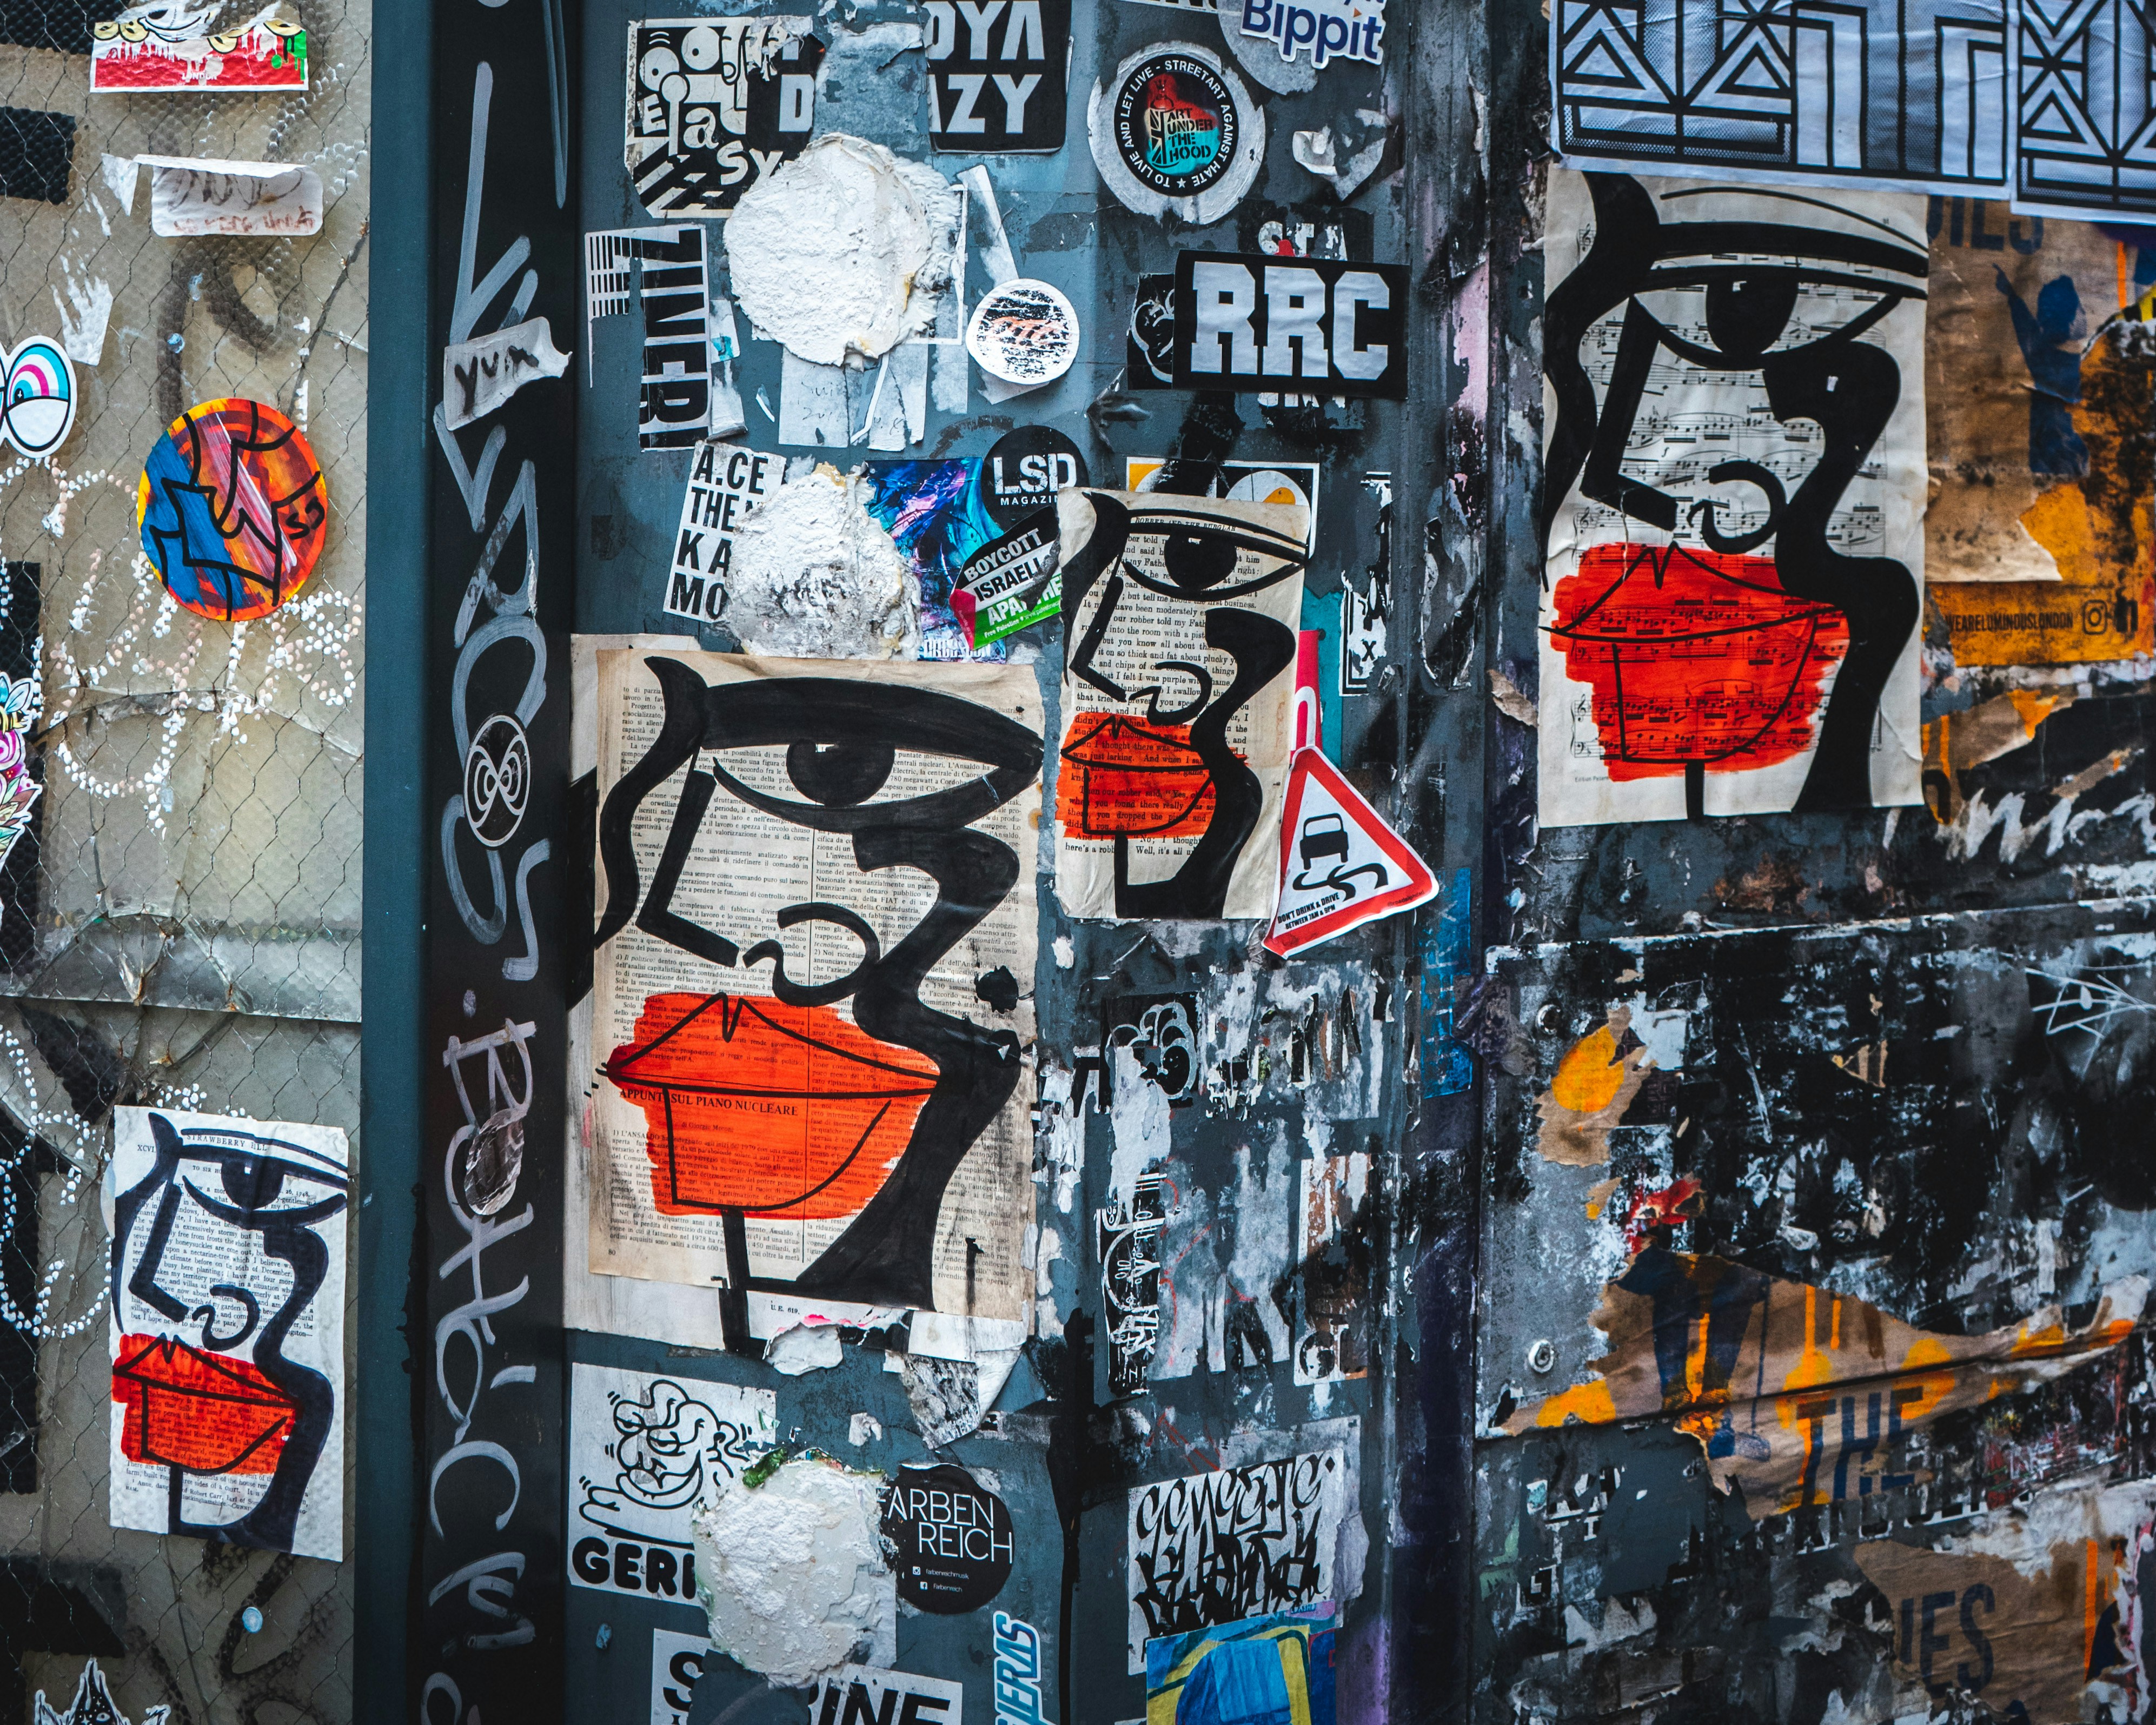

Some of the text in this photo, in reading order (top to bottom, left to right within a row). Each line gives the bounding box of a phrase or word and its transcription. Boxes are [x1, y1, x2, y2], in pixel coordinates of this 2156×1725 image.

[1242, 0, 1382, 63] Bippit
[1130, 66, 1154, 92] LIVE
[1120, 91, 1134, 118] LET
[1167, 119, 1212, 135] UNDER
[1220, 104, 1233, 162] AGAINST
[1121, 122, 1135, 148] AND
[1168, 133, 1196, 148] THE
[1169, 145, 1211, 163] HOOD
[1130, 150, 1152, 178] LIVE
[1192, 160, 1221, 187] HATE
[1155, 174, 1170, 188] TO
[1191, 261, 1389, 380] RRC
[993, 453, 1077, 495] LSD
[691, 486, 739, 532] THE
[1144, 535, 1158, 544] told
[964, 528, 1041, 582] BOYCOTT
[1140, 546, 1155, 554] said
[670, 572, 728, 619] MO
[1143, 593, 1155, 601] tell
[1224, 599, 1256, 608] business.
[1157, 607, 1197, 617] moderately
[984, 629, 996, 638] Free
[997, 619, 1019, 631] Palestine
[1175, 620, 1186, 628] my
[1103, 636, 1114, 645] but
[1137, 639, 1157, 647] know
[1128, 649, 1147, 658] thick
[1150, 651, 1164, 659] and
[1180, 653, 1201, 661] about
[1204, 655, 1228, 666] plucky
[1116, 661, 1135, 670] chips
[1212, 667, 1235, 675] things
[1124, 672, 1136, 680] felt
[1163, 675, 1186, 685] purple
[1077, 692, 1093, 701] that
[1076, 705, 1099, 714] ought
[1075, 716, 1099, 725] didn't
[1102, 740, 1132, 751] thought
[1144, 754, 1159, 762] And
[715, 829, 757, 838] valorizzazione
[855, 879, 904, 888] sostanzialmente
[816, 892, 859, 902] Finmeccanica,
[893, 890, 921, 898] pubblico
[1277, 910, 1295, 924] DON'T
[1296, 903, 1315, 916] DRINK
[1321, 892, 1340, 905] DRIVE
[1285, 916, 1308, 929] BETWEEN
[1309, 912, 1319, 920] 7AM
[1325, 904, 1336, 913] 9PM
[671, 1093, 693, 1105] SUL
[696, 1097, 732, 1109] PIANO
[735, 1100, 798, 1116] NUCLEARE
[187, 1134, 245, 1147] STRAWBERRY
[183, 1224, 237, 1238] excessively stormy
[176, 1239, 213, 1250] honeysuckles
[170, 1254, 191, 1263] climate
[164, 1262, 177, 1270] busy
[262, 1267, 292, 1277] December.
[183, 1272, 208, 1283] territory
[182, 1297, 204, 1305] breadth
[919, 1521, 1012, 1564] REICH
